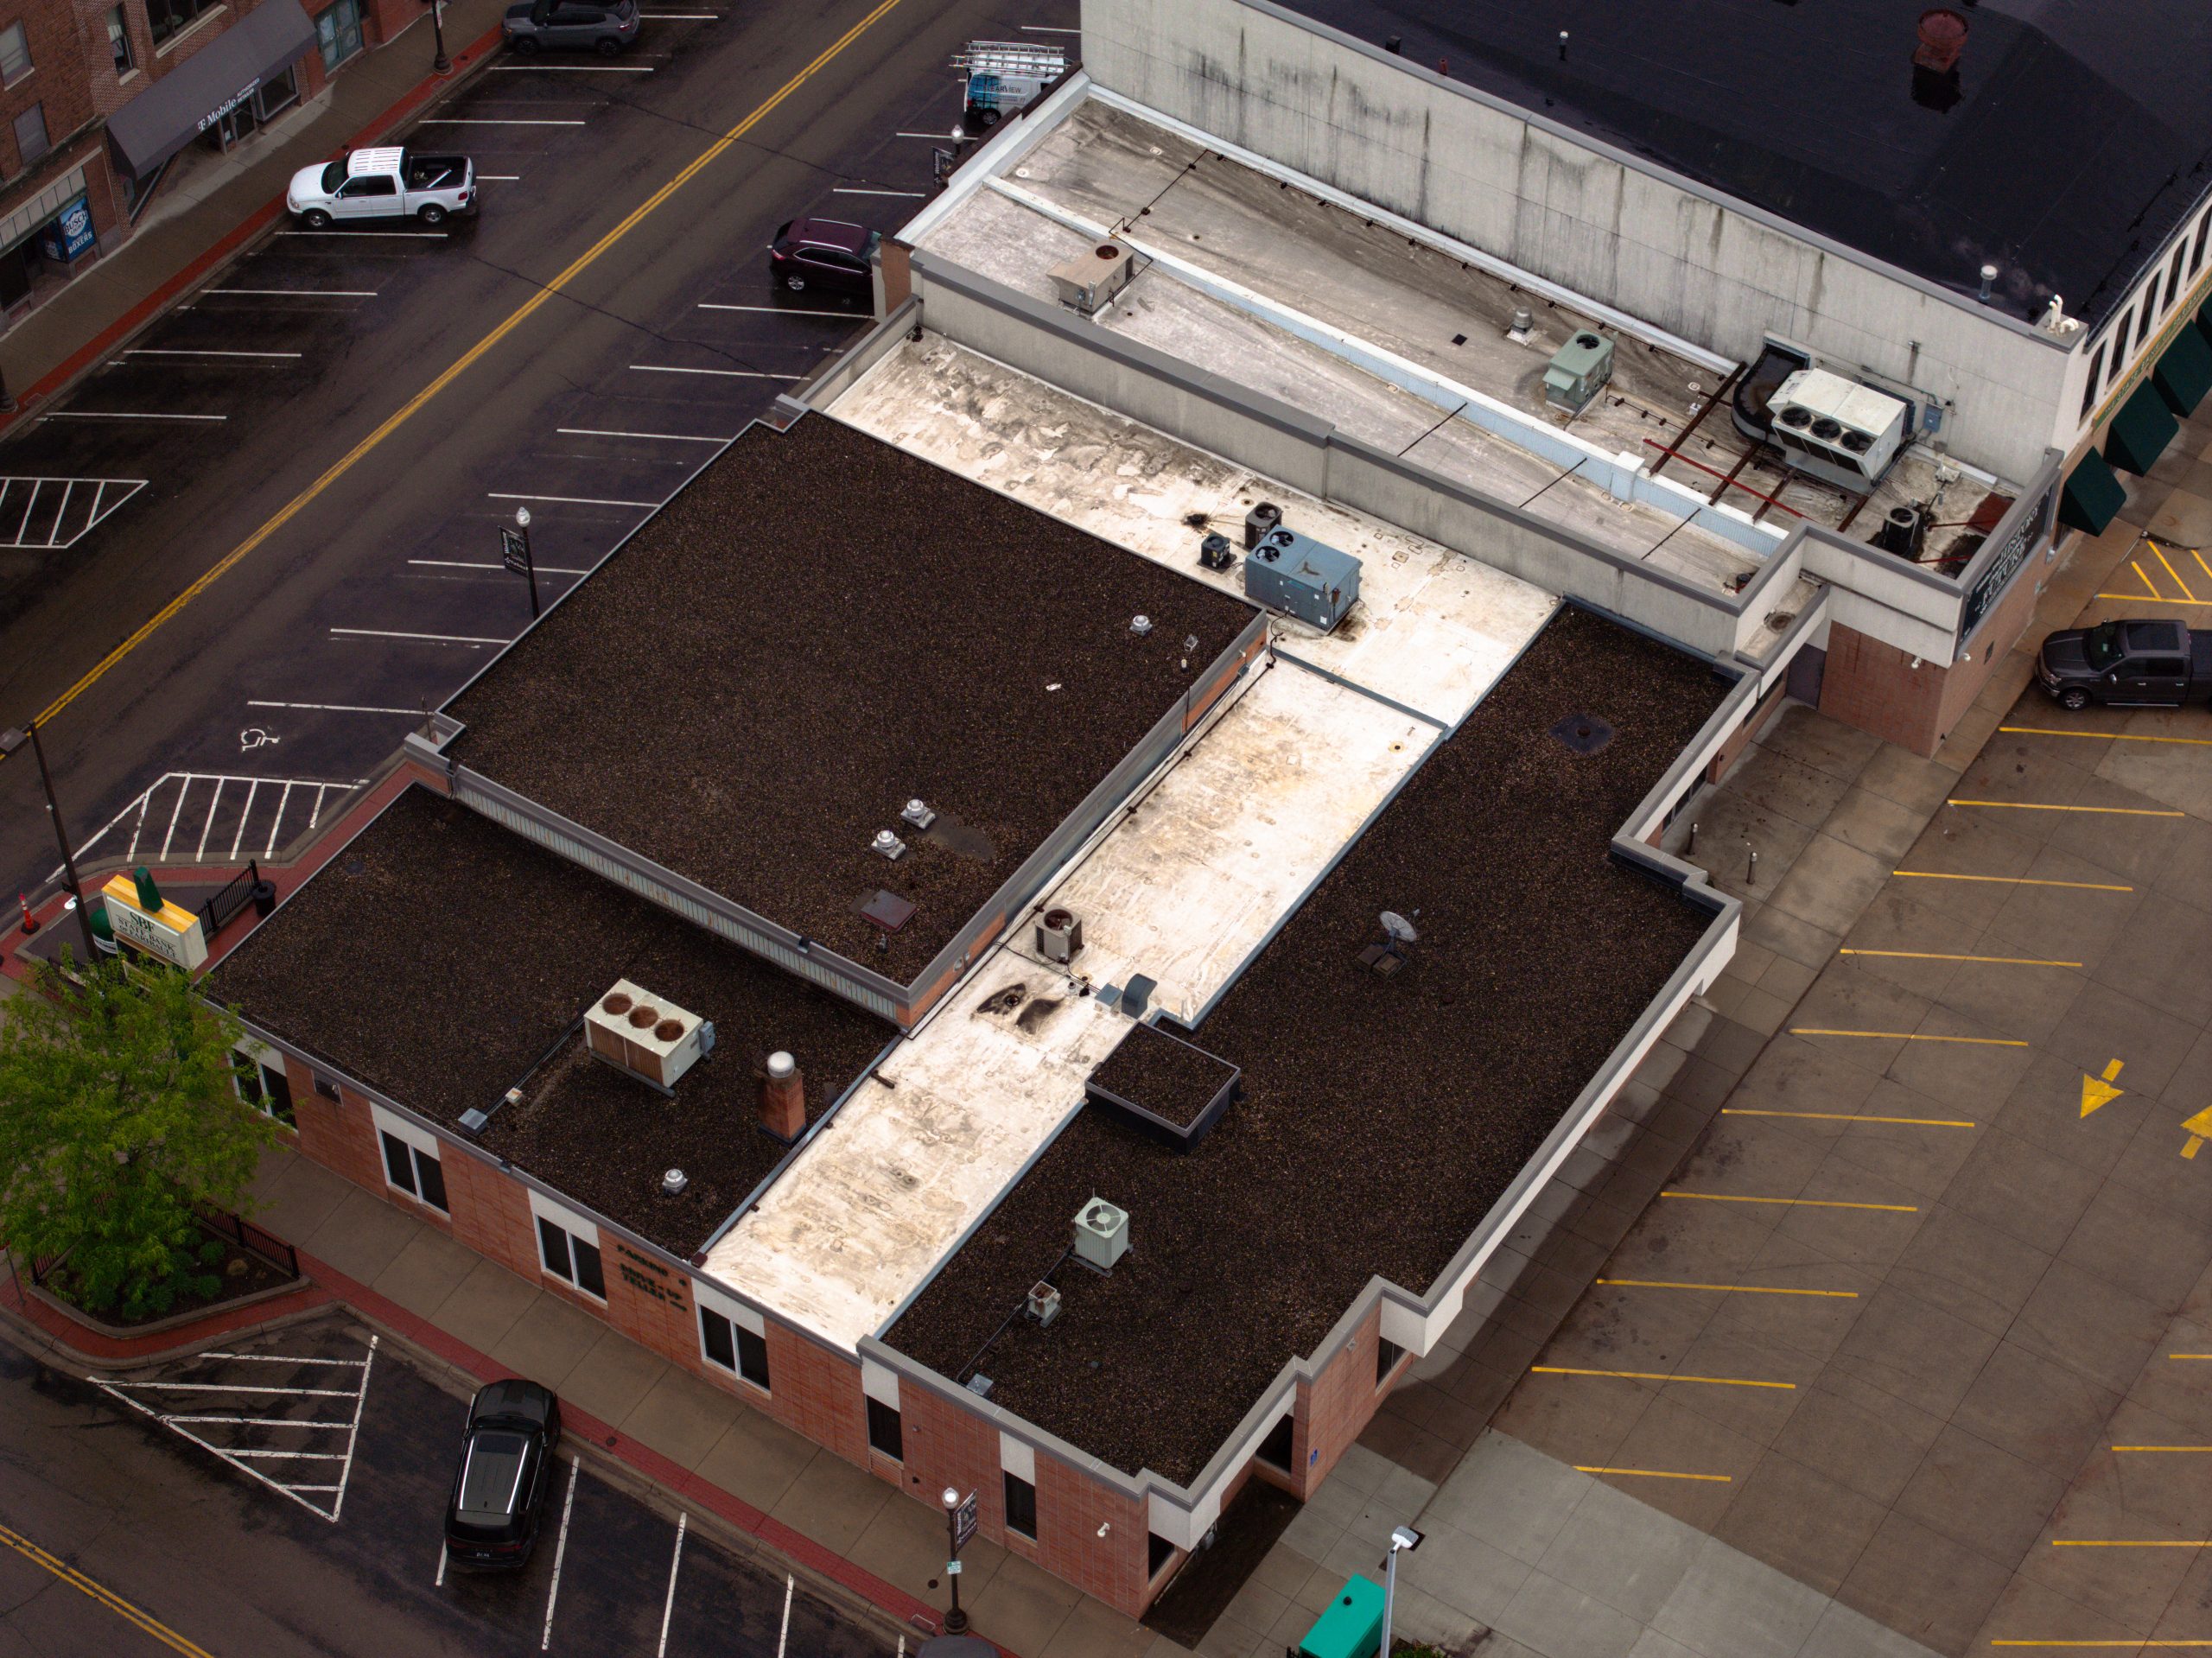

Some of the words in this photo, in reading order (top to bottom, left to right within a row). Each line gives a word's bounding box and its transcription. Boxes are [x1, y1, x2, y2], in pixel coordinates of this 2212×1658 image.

[237, 77, 260, 97] AUTHORIZED
[237, 87, 255, 104] RETAILER
[207, 98, 237, 126] Mobile
[63, 209, 89, 235] BUSCH
[70, 221, 85, 235] LIGHT
[68, 231, 92, 254] BOXERS
[118, 918, 146, 934] STATE
[149, 931, 176, 950] BANK
[130, 912, 155, 932] SBF
[129, 929, 177, 959] FARIBAULT
[617, 1244, 668, 1277] PARKING
[622, 1274, 666, 1302] TELLER
